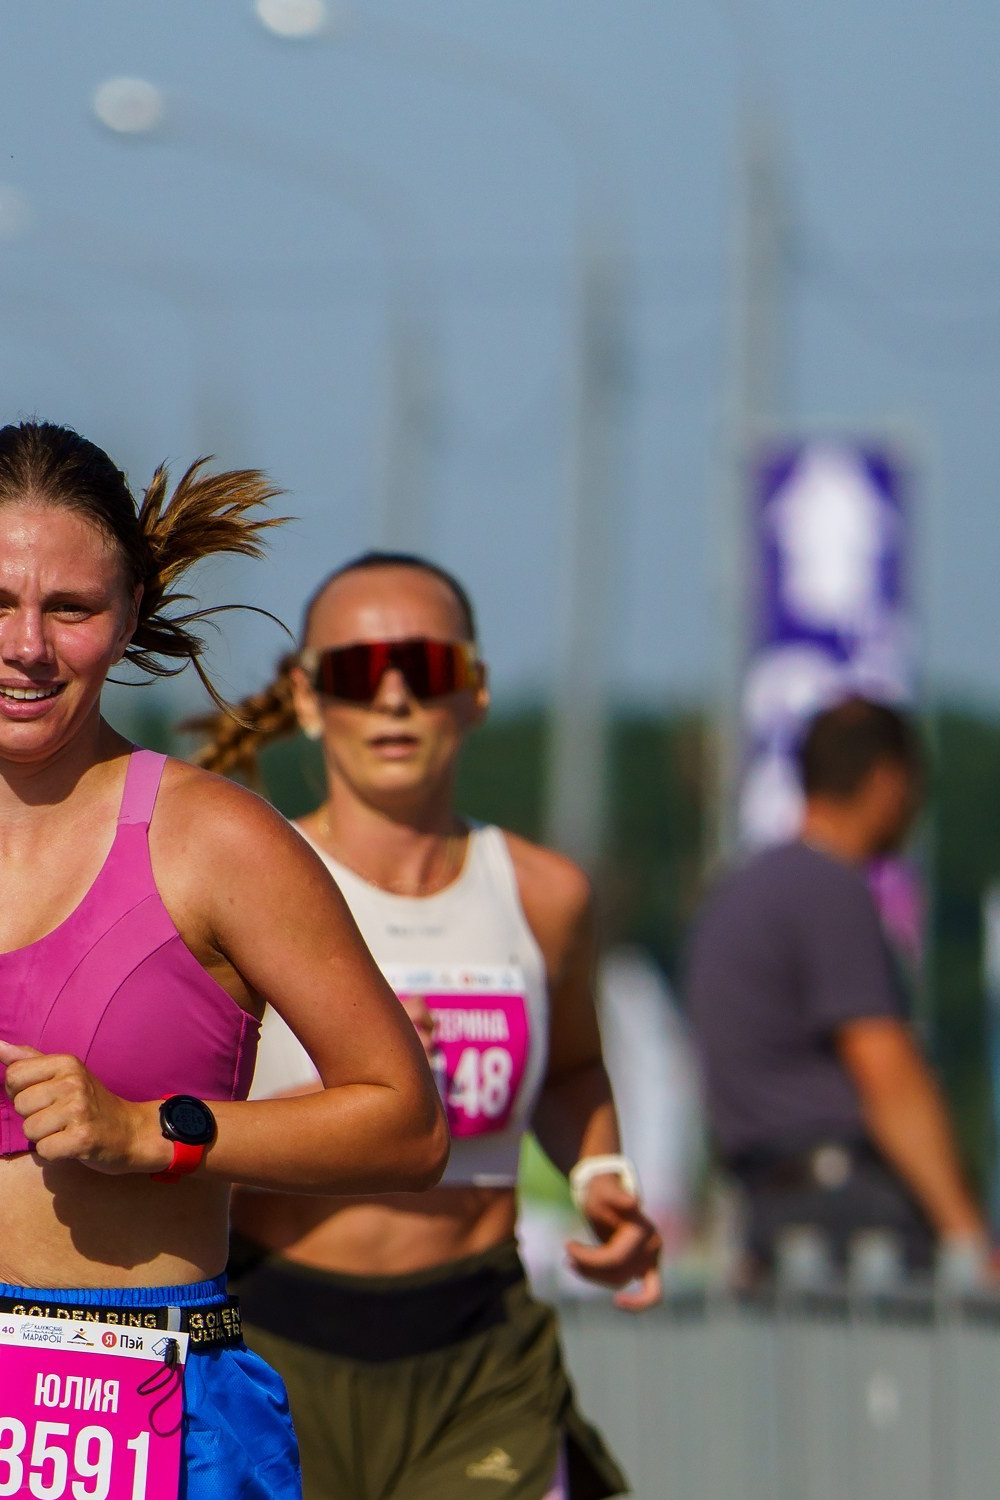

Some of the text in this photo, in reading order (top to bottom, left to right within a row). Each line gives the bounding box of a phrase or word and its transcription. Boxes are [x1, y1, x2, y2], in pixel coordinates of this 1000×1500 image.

[1, 1326, 15, 1335] 40
[22, 1332, 62, 1344] МАРАФОН
[119, 1334, 144, 1350] Пэй
[34, 1371, 119, 1413] ЮЛИЯ
